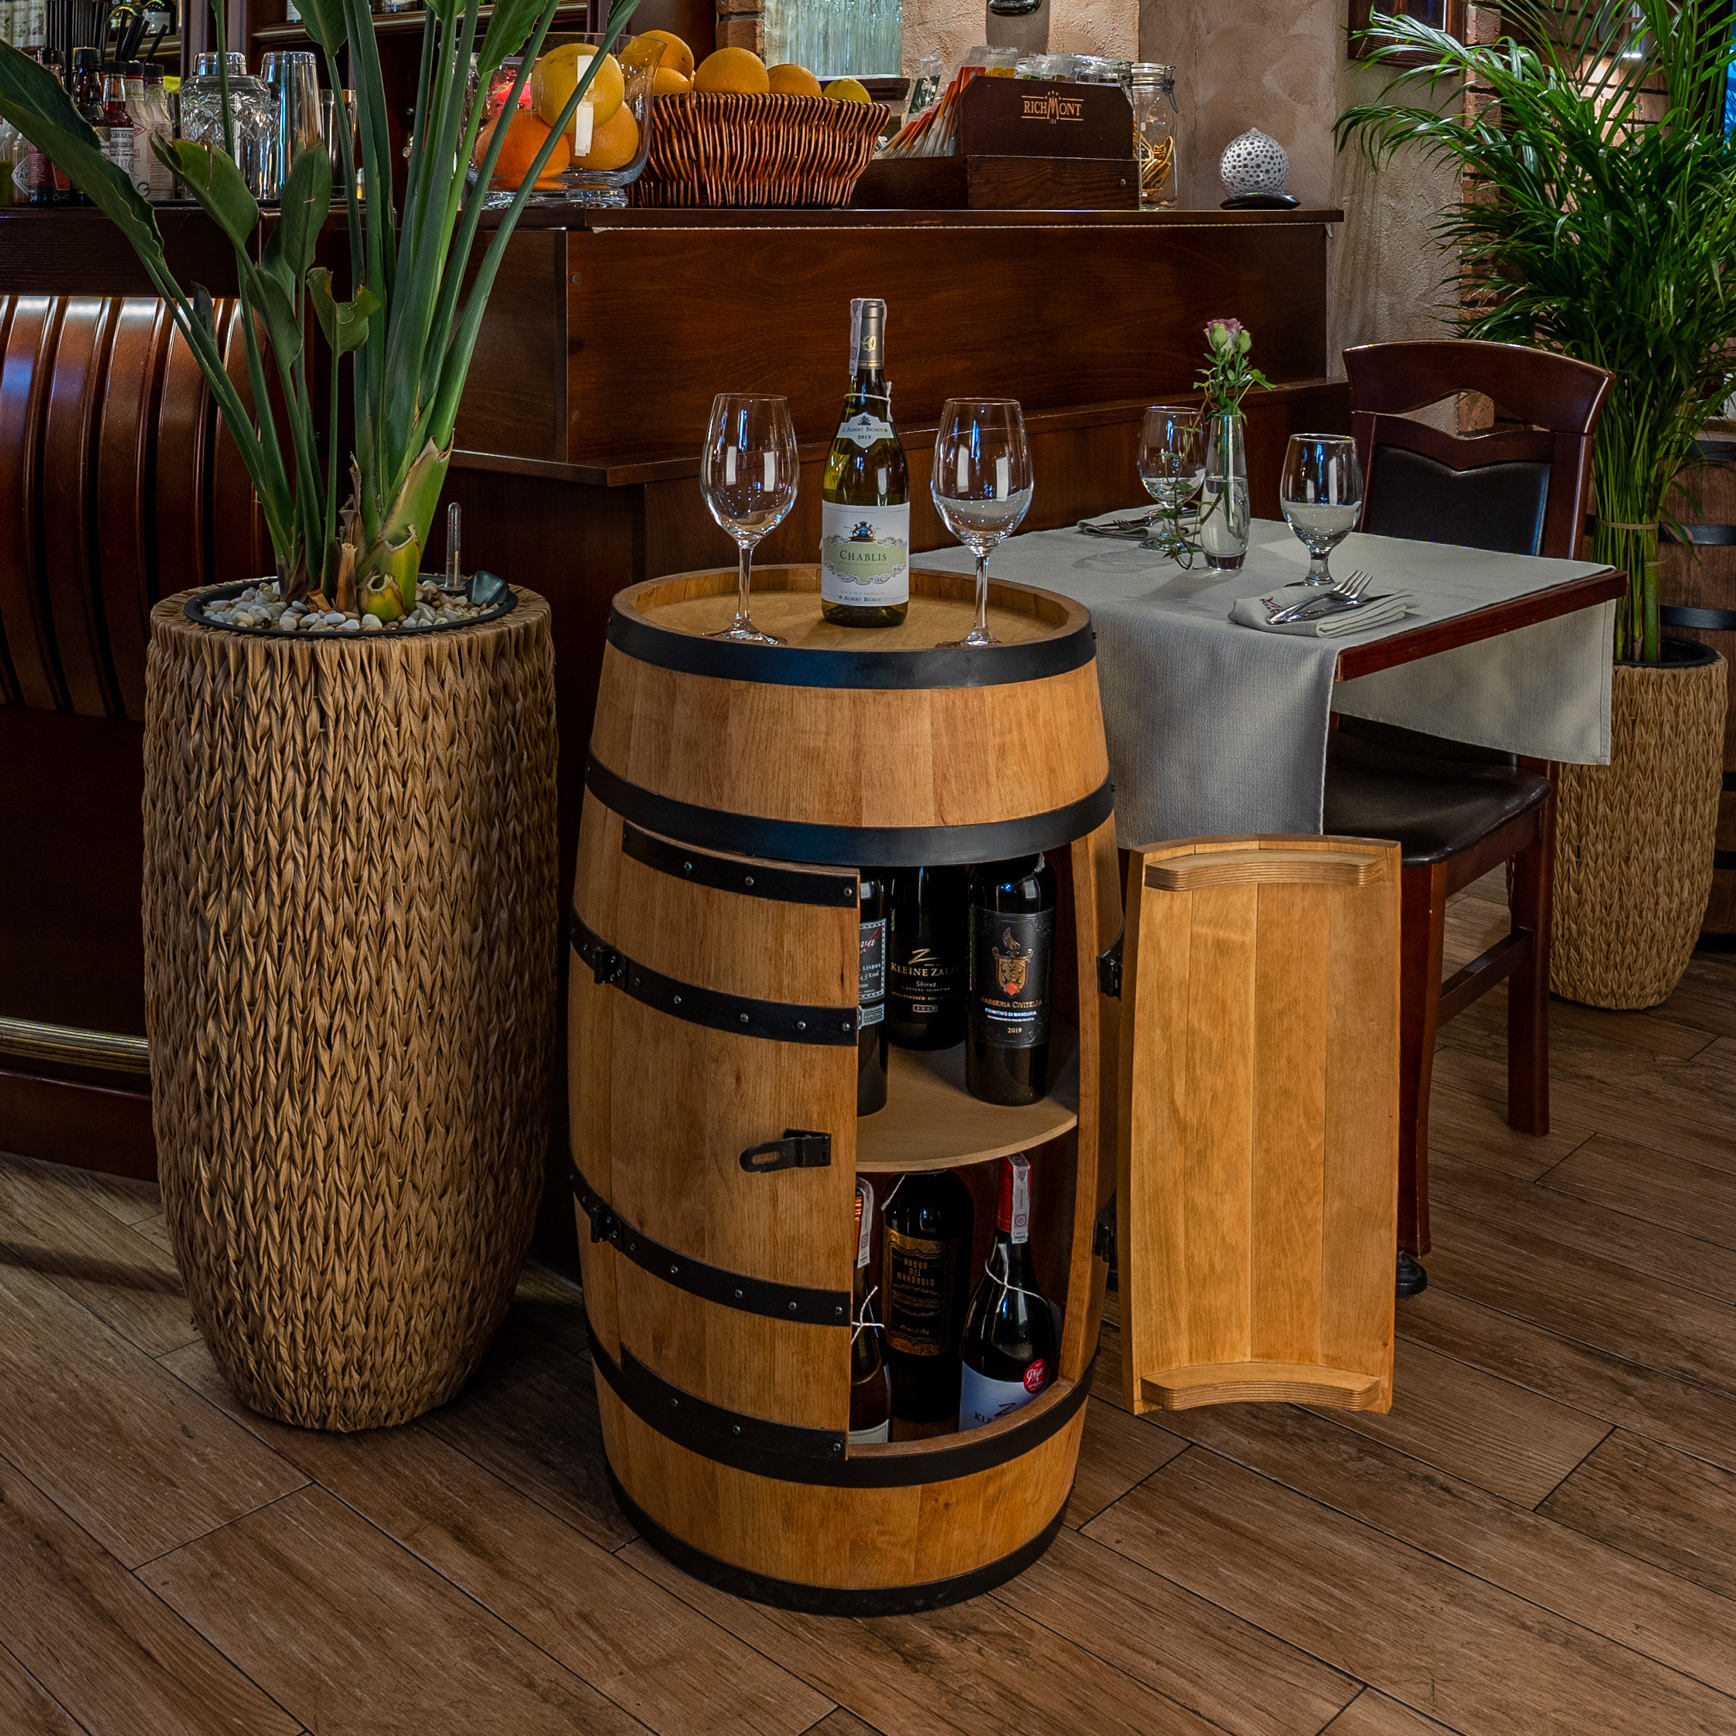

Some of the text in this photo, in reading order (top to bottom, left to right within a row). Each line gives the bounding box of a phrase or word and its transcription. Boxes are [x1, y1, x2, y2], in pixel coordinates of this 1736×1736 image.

[1023, 97, 1082, 120] RICHMONT
[839, 549, 888, 562] CHABLIS
[891, 961, 929, 977] KLEINE
[915, 980, 937, 988] Shiraz
[974, 1411, 993, 1424] KLE
